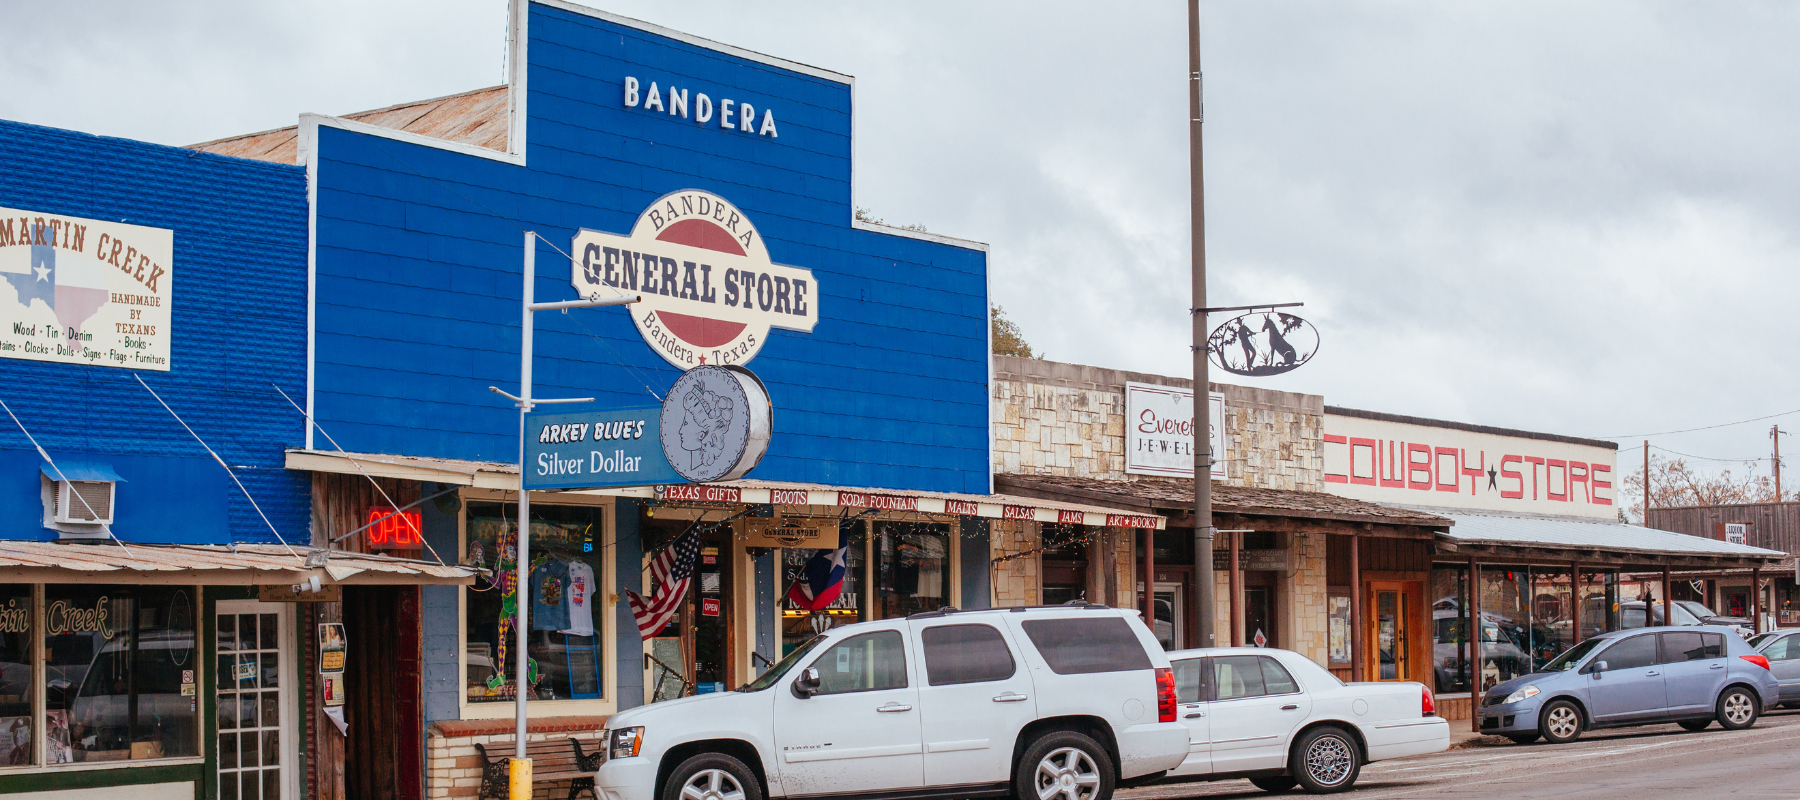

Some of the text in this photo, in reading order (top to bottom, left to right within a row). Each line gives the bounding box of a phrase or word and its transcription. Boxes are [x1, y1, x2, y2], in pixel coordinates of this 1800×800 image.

[623, 76, 778, 138] BANDERA
[648, 195, 754, 250] BANDERA
[0, 217, 165, 294] MARTIN CREEK
[582, 242, 808, 317] GENERAL STORE
[111, 292, 161, 308] HANDMADE
[129, 309, 142, 321] BY
[13, 321, 93, 342] Wood Tin Denim
[115, 322, 156, 336] TEXANS
[124, 335, 147, 350] Books
[642, 310, 757, 368] Bandera Texas
[24, 340, 49, 355] Clocks
[57, 343, 75, 357] Dolls
[82, 346, 102, 361] Signs
[109, 348, 128, 364] Flags
[135, 351, 166, 365] Furniture
[539, 419, 646, 444] ARKEY BLUE'S
[537, 450, 642, 476] Silver Dollar
[1323, 433, 1613, 506] COWBOY STORE
[662, 485, 701, 500] TEXAS
[706, 487, 738, 502] GIFTS
[772, 490, 807, 505] BOOTS
[840, 493, 919, 510] SODA FOUNTAIN
[947, 501, 978, 515] MALTS
[1004, 506, 1036, 520] SALSAS
[1061, 511, 1083, 524] JAMS
[1108, 515, 1156, 529] ART BOOKS
[368, 511, 422, 544] OPEN
[1728, 525, 1743, 535] LIQUOR
[705, 603, 718, 612] OPEN
[46, 595, 114, 639] Creek
